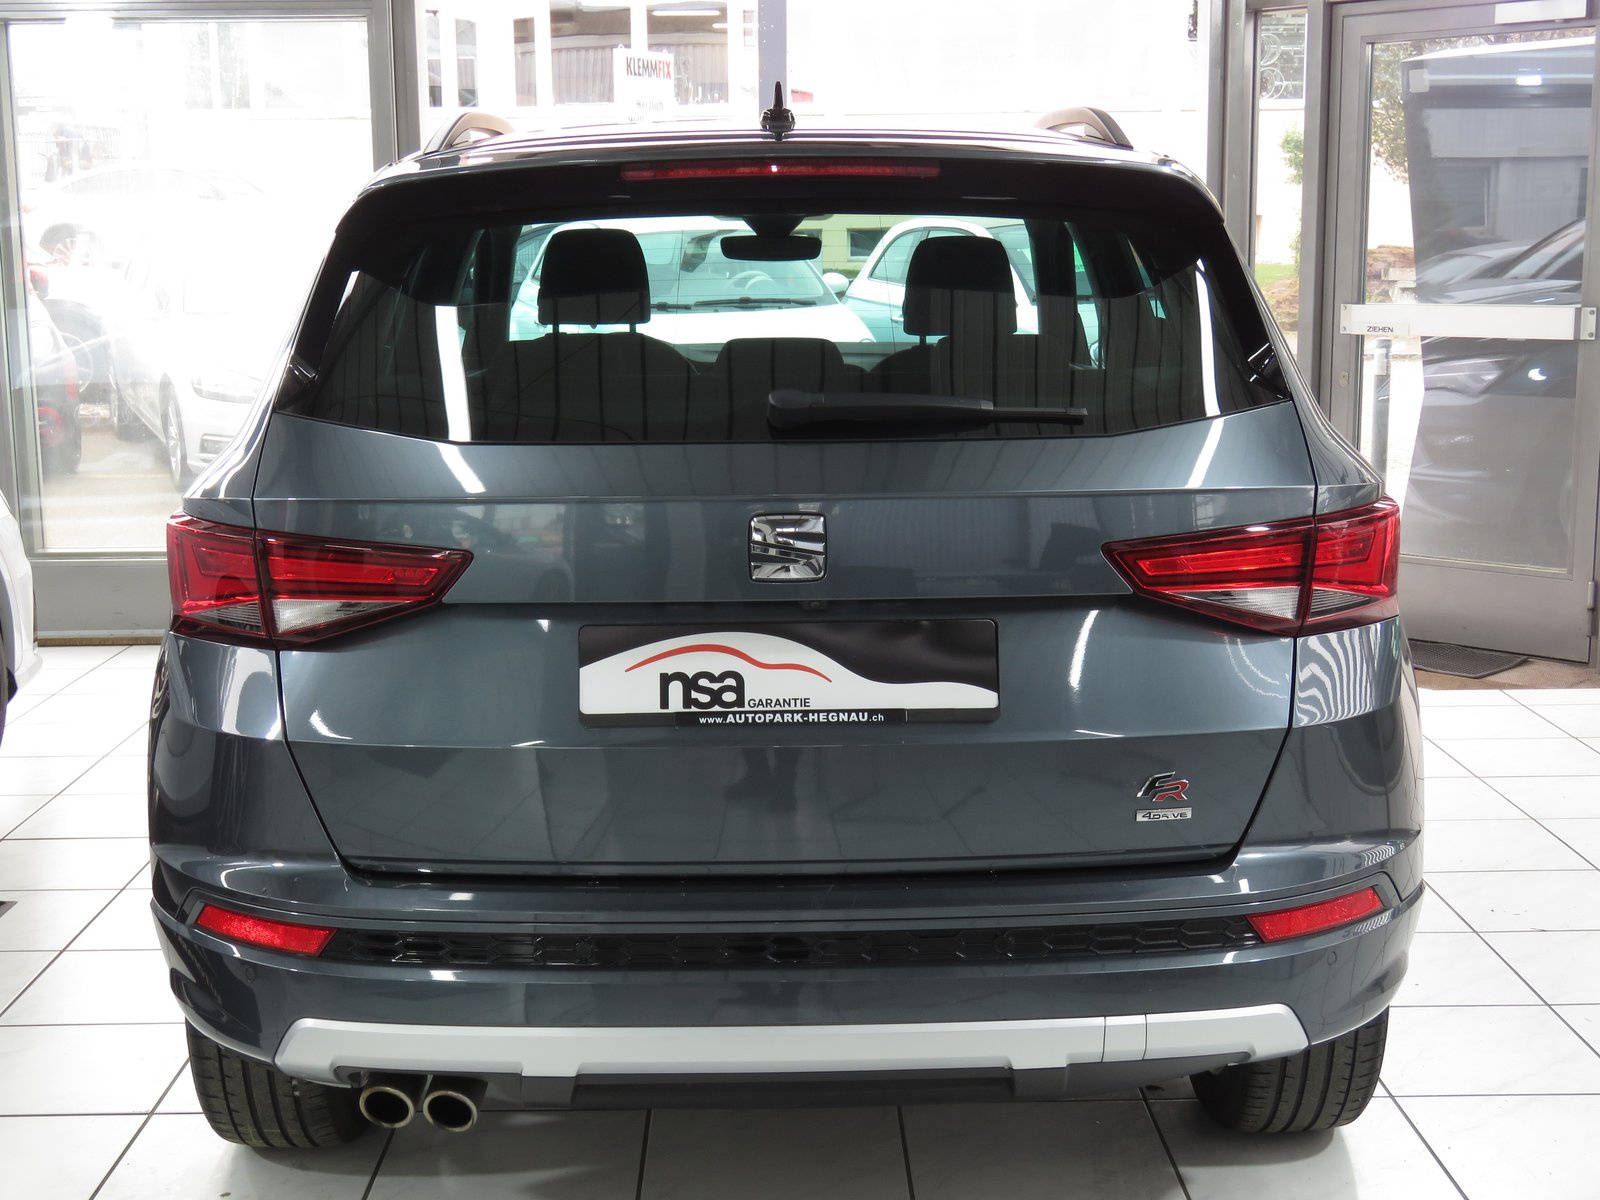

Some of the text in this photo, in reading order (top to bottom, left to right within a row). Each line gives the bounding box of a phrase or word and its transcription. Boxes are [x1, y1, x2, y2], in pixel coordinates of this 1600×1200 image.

[626, 56, 671, 80] KLEMMFIX
[1366, 325, 1394, 333] ZIEHEN
[659, 670, 745, 710] nsa
[747, 697, 811, 709] GARANTIE
[698, 712, 885, 724] www.AUTOPARK-HEGNAU.ch
[1136, 771, 1189, 802] FR
